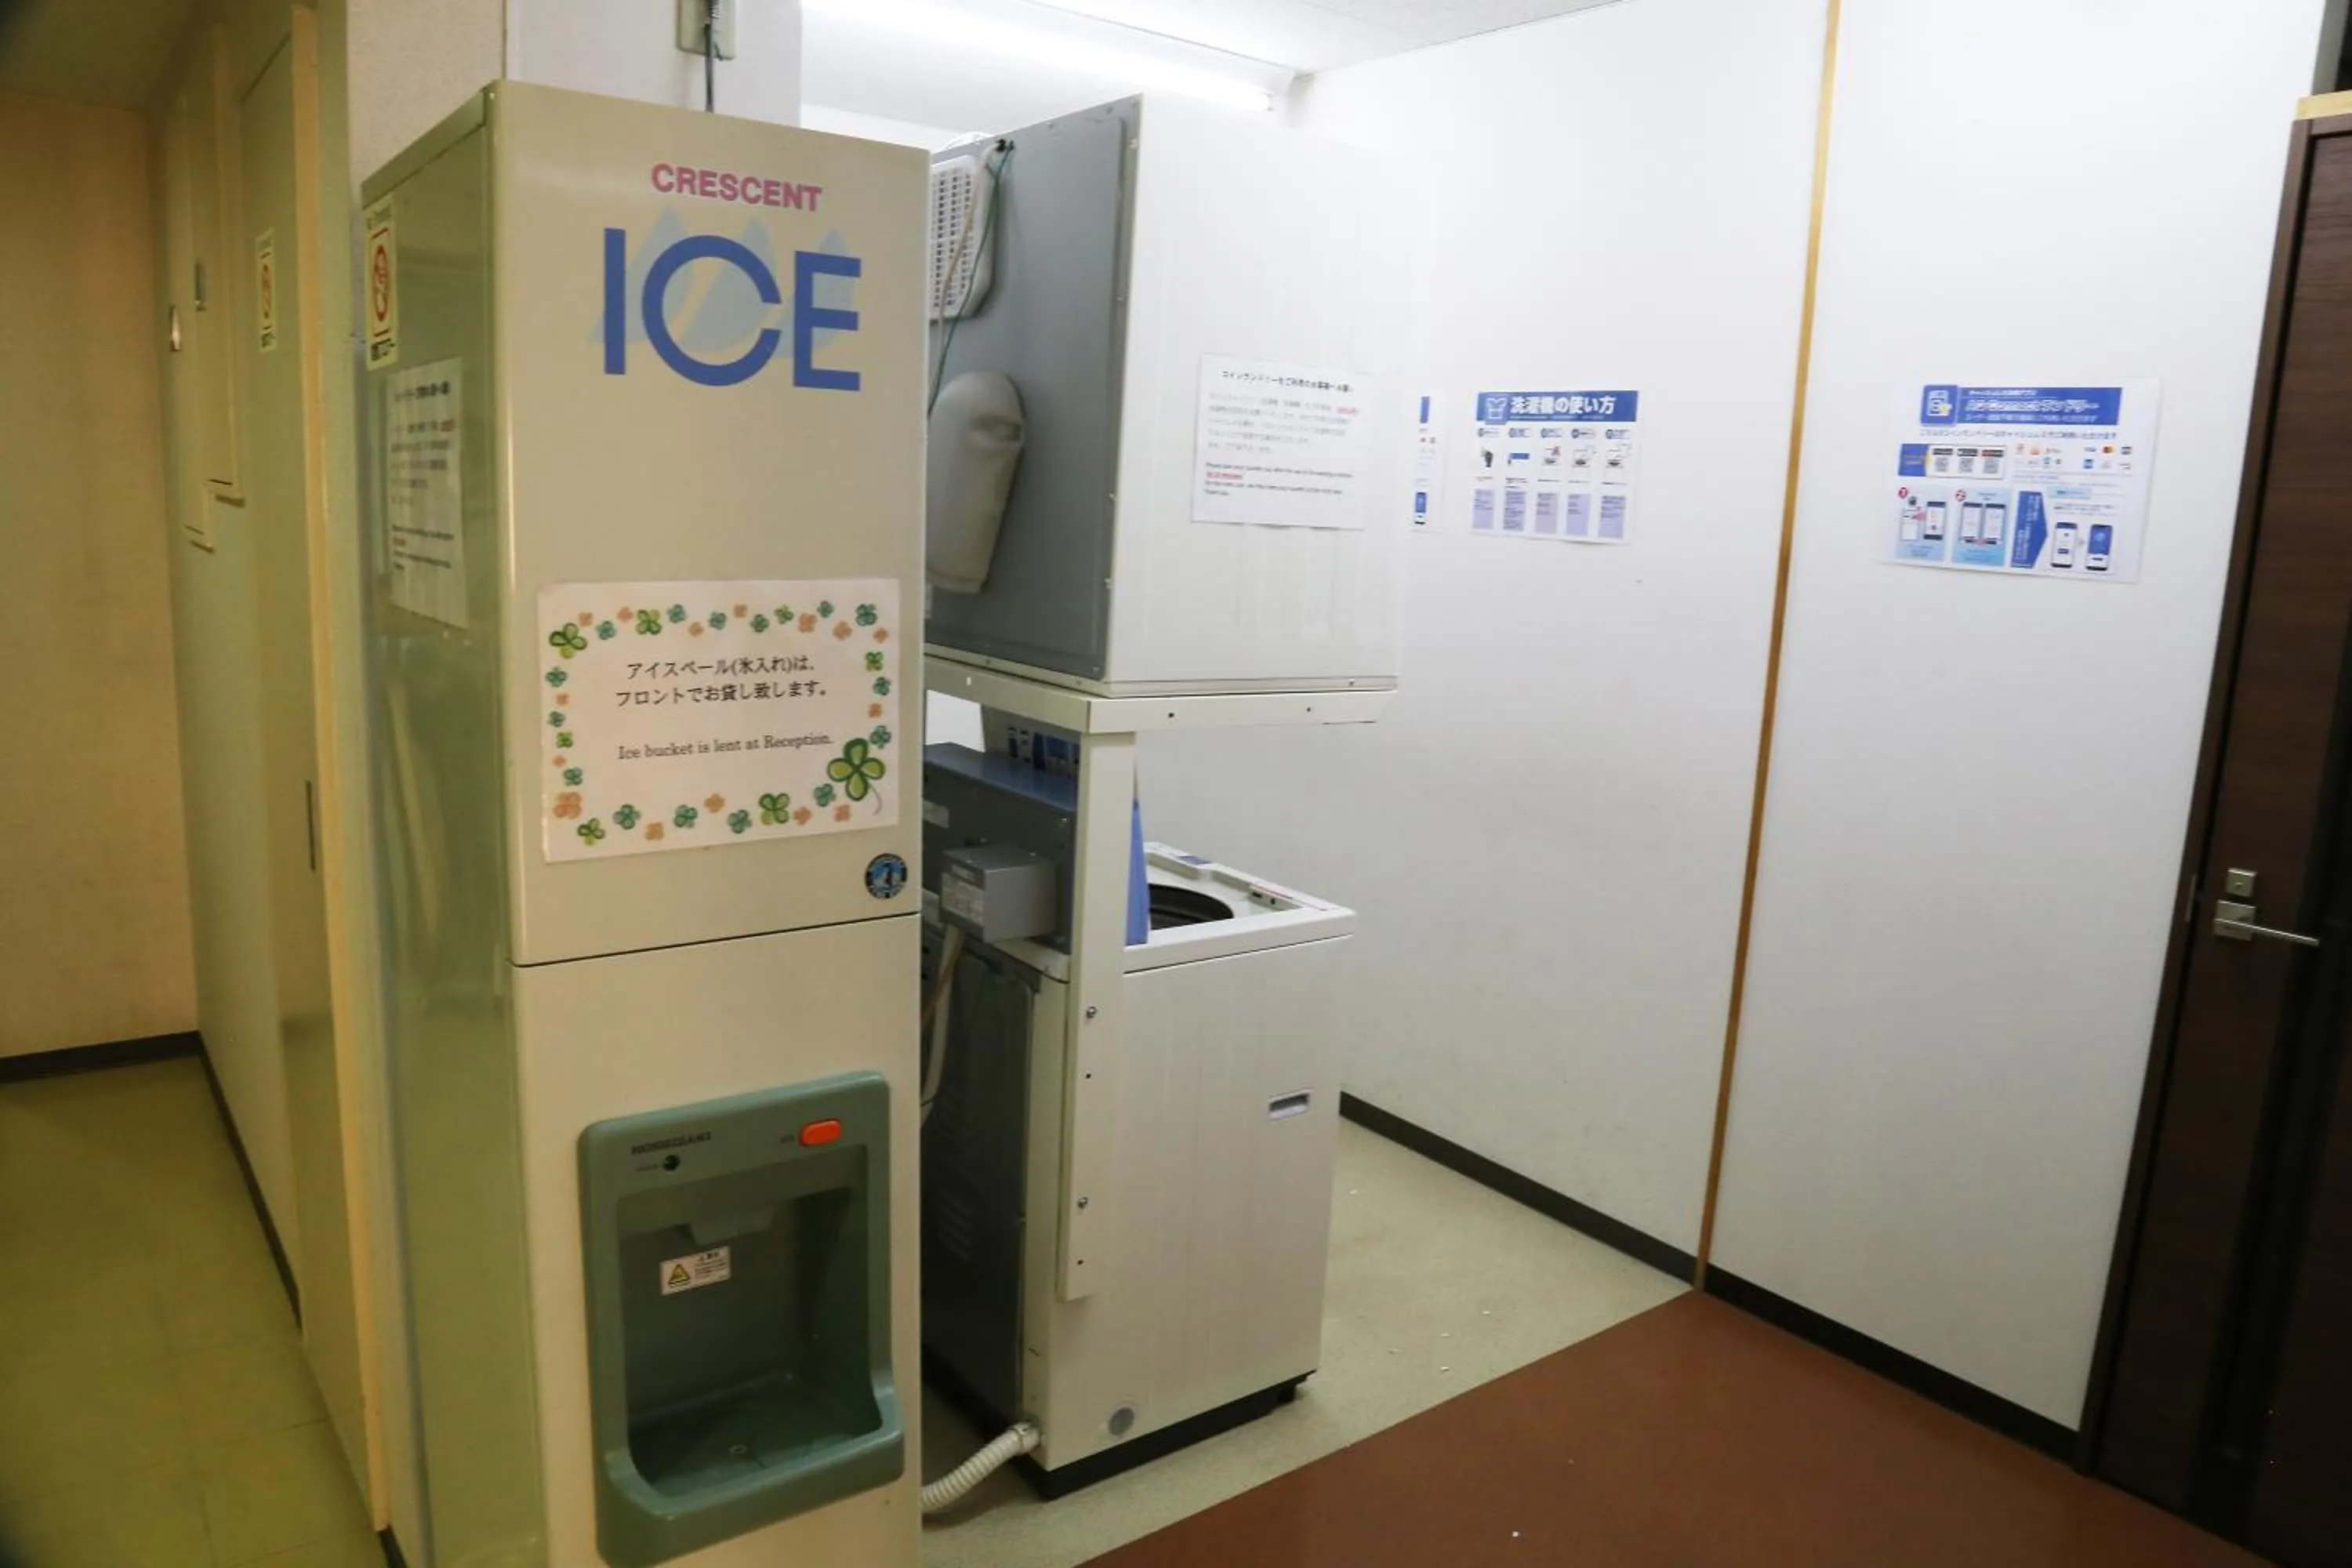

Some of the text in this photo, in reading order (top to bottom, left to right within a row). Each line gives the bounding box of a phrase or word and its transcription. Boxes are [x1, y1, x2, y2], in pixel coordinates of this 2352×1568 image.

[652, 163, 822, 212] CRESCENT
[604, 227, 862, 391] ICE
[615, 680, 828, 706] フロントでお貸し致します。
[618, 745, 641, 760] Ice
[644, 742, 694, 758] bucket
[697, 741, 710, 753] is
[713, 739, 742, 753] lent
[745, 739, 761, 750] at
